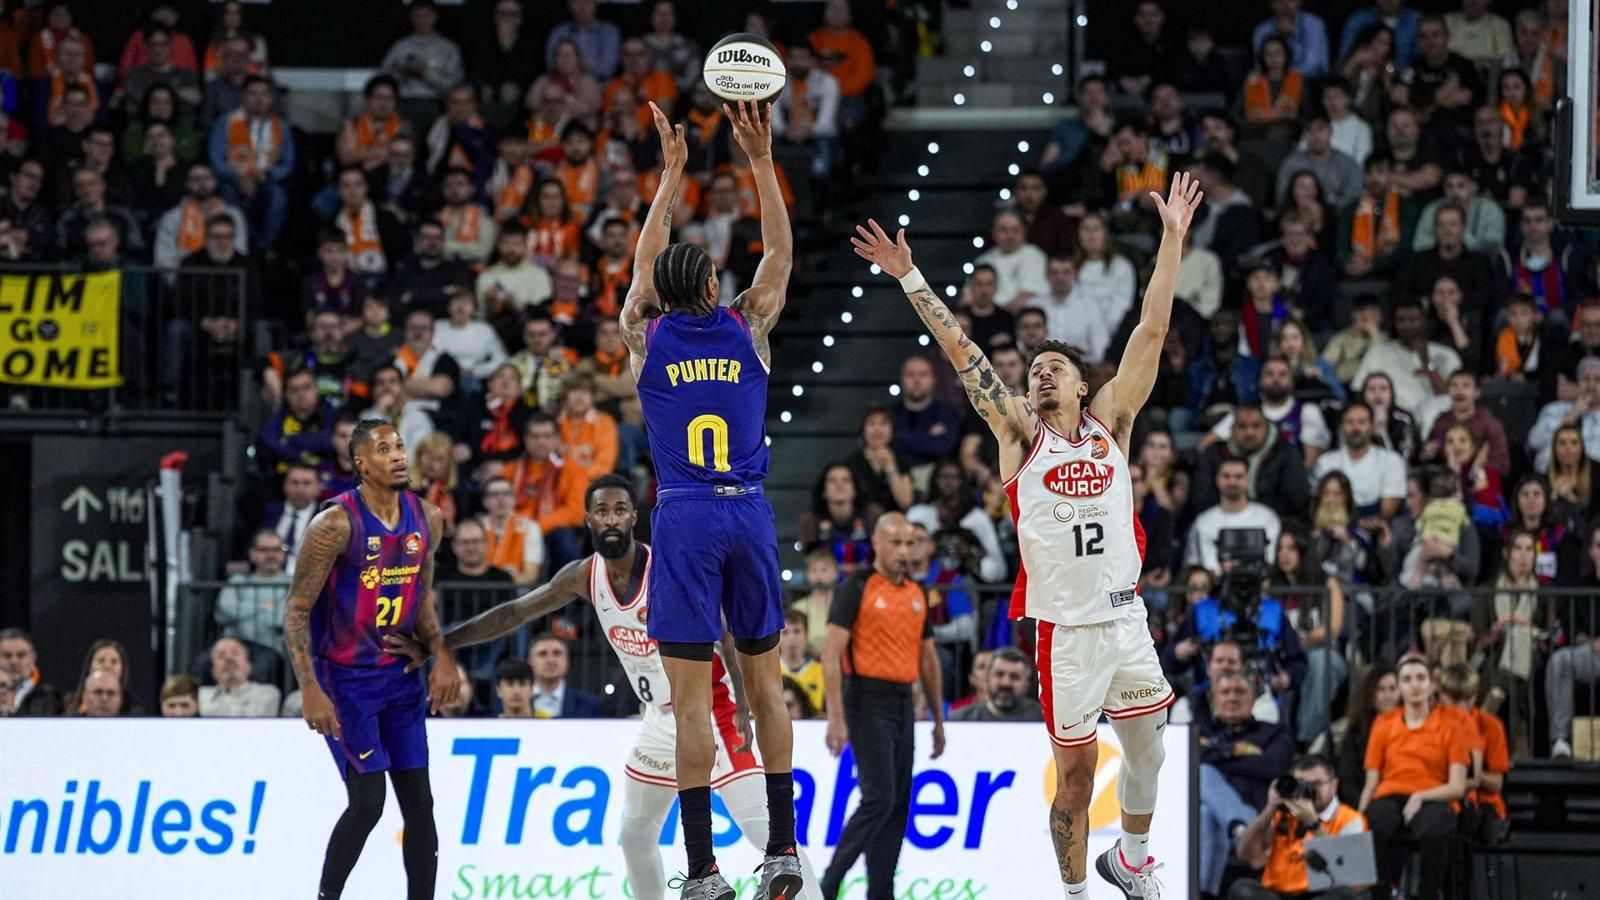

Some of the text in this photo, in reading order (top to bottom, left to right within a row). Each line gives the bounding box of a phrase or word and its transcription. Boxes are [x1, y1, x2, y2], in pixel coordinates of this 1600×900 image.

[717, 49, 771, 67] Wilson
[715, 77, 740, 89] Copa
[754, 82, 771, 91] Rey
[665, 358, 742, 387] PUNTER
[687, 414, 732, 473] 0
[1057, 462, 1109, 480] UCAM
[1050, 477, 1114, 496] MURCIA
[1072, 522, 1105, 558] 12
[376, 596, 403, 628] 21
[613, 627, 648, 643] UCAM
[638, 675, 654, 702] 8
[0, 780, 267, 854] nibles!
[452, 865, 613, 900] Smart
